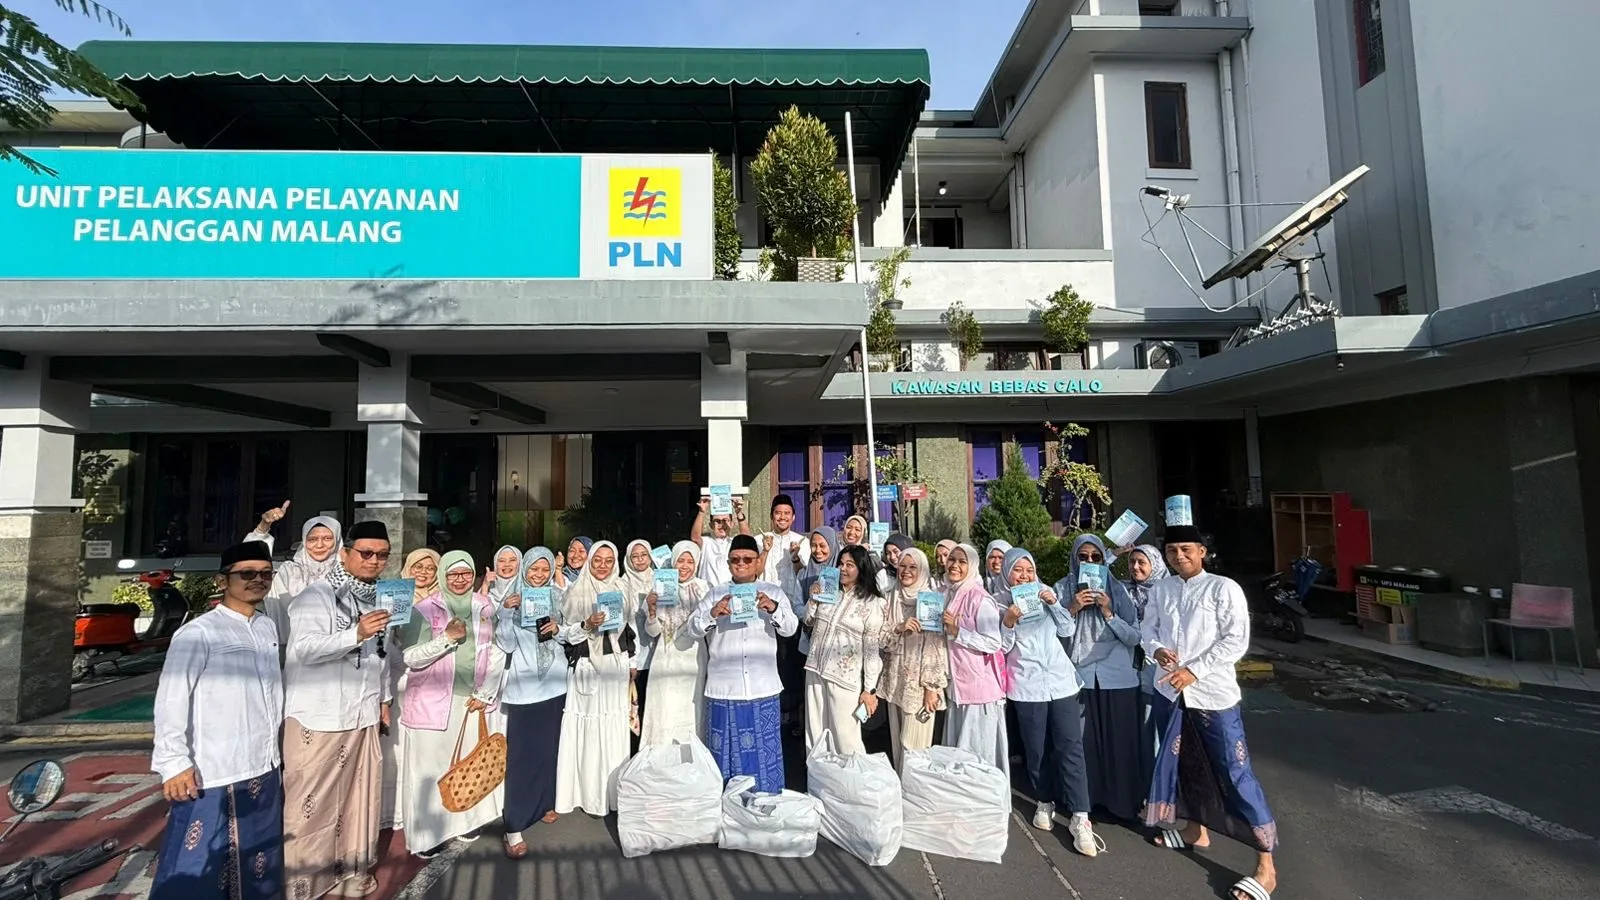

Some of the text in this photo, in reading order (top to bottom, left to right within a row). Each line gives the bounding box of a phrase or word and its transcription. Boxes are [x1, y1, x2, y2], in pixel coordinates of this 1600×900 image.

[16, 185, 460, 212] UNIT PELAKSANA PELAYANAN
[73, 218, 402, 244] PELANGGAN MALANG
[608, 241, 682, 268] PLN
[891, 379, 1104, 394] KAWASAN BEBAS CALO
[1393, 580, 1420, 590] MALANG
